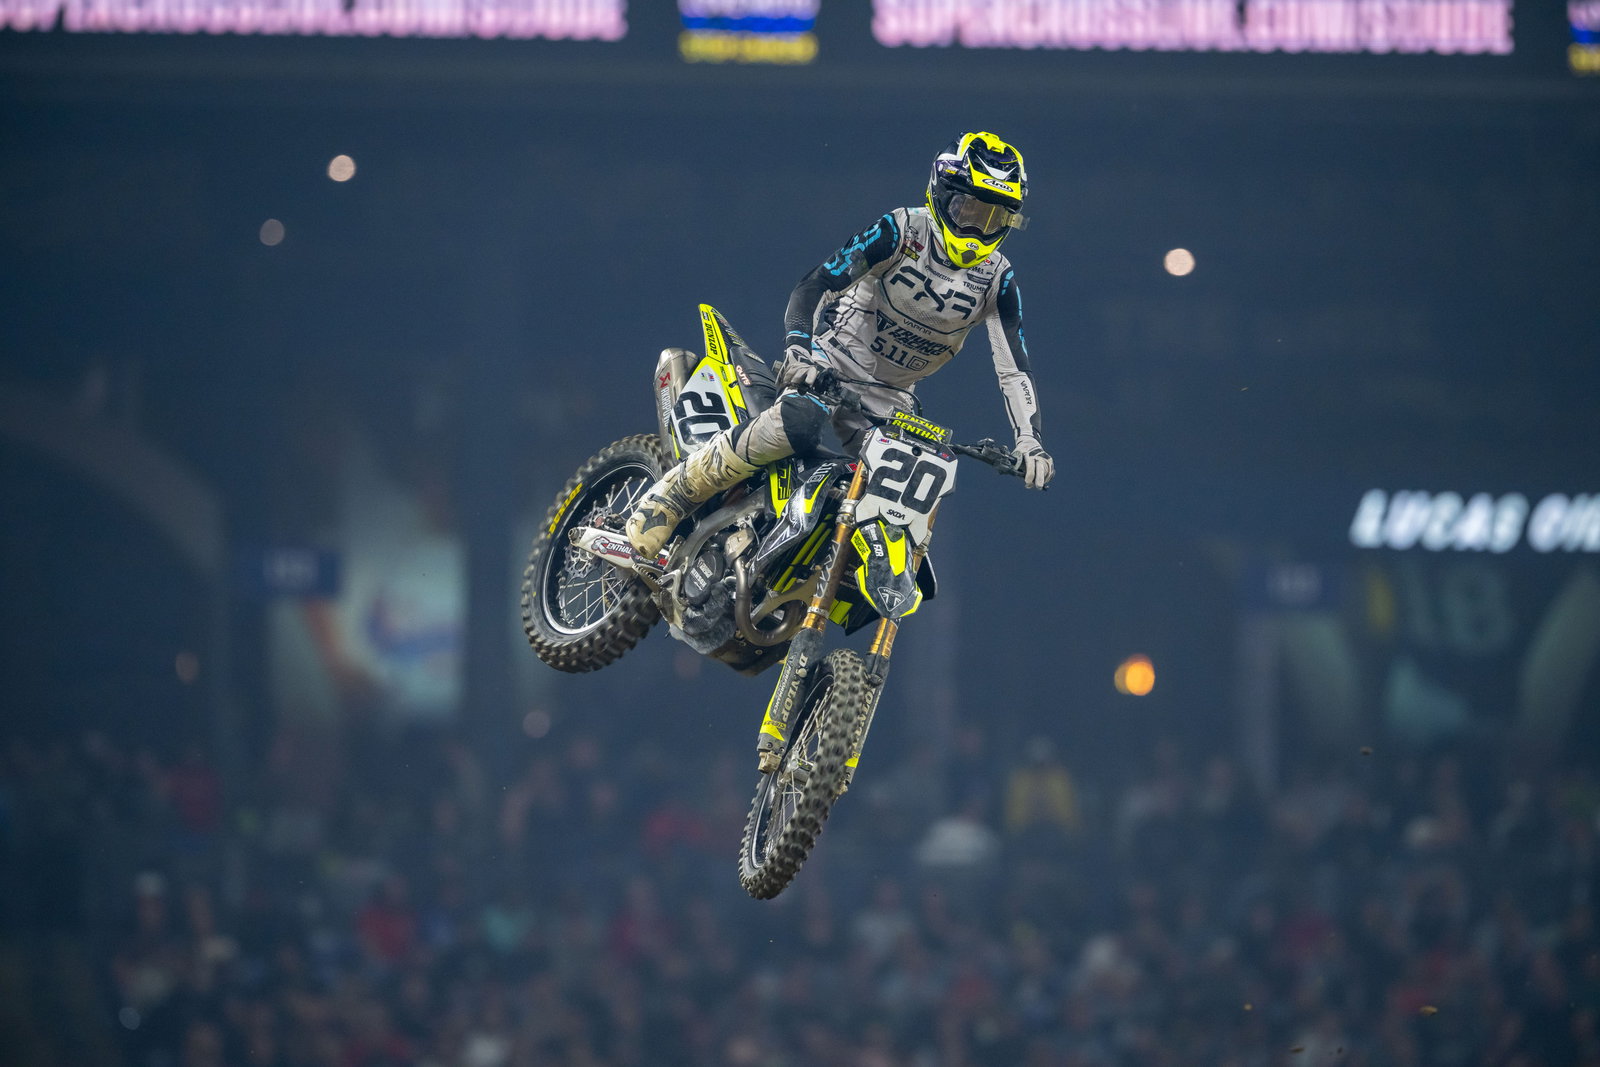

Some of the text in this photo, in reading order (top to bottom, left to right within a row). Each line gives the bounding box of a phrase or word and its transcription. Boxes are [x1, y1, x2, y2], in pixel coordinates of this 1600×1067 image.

[889, 265, 977, 321] FXR
[963, 281, 986, 293] TRIUMP
[704, 322, 718, 356] DUNLOP
[893, 326, 952, 352] TRIUMPH
[903, 319, 932, 335] VAPOR
[869, 335, 909, 368] 5.11
[888, 331, 942, 357] RACING
[736, 364, 751, 386] GUTS
[673, 391, 731, 446] 20
[895, 411, 948, 437] RENTHAL
[866, 448, 947, 515] 20
[1351, 490, 1529, 552] LUCAS
